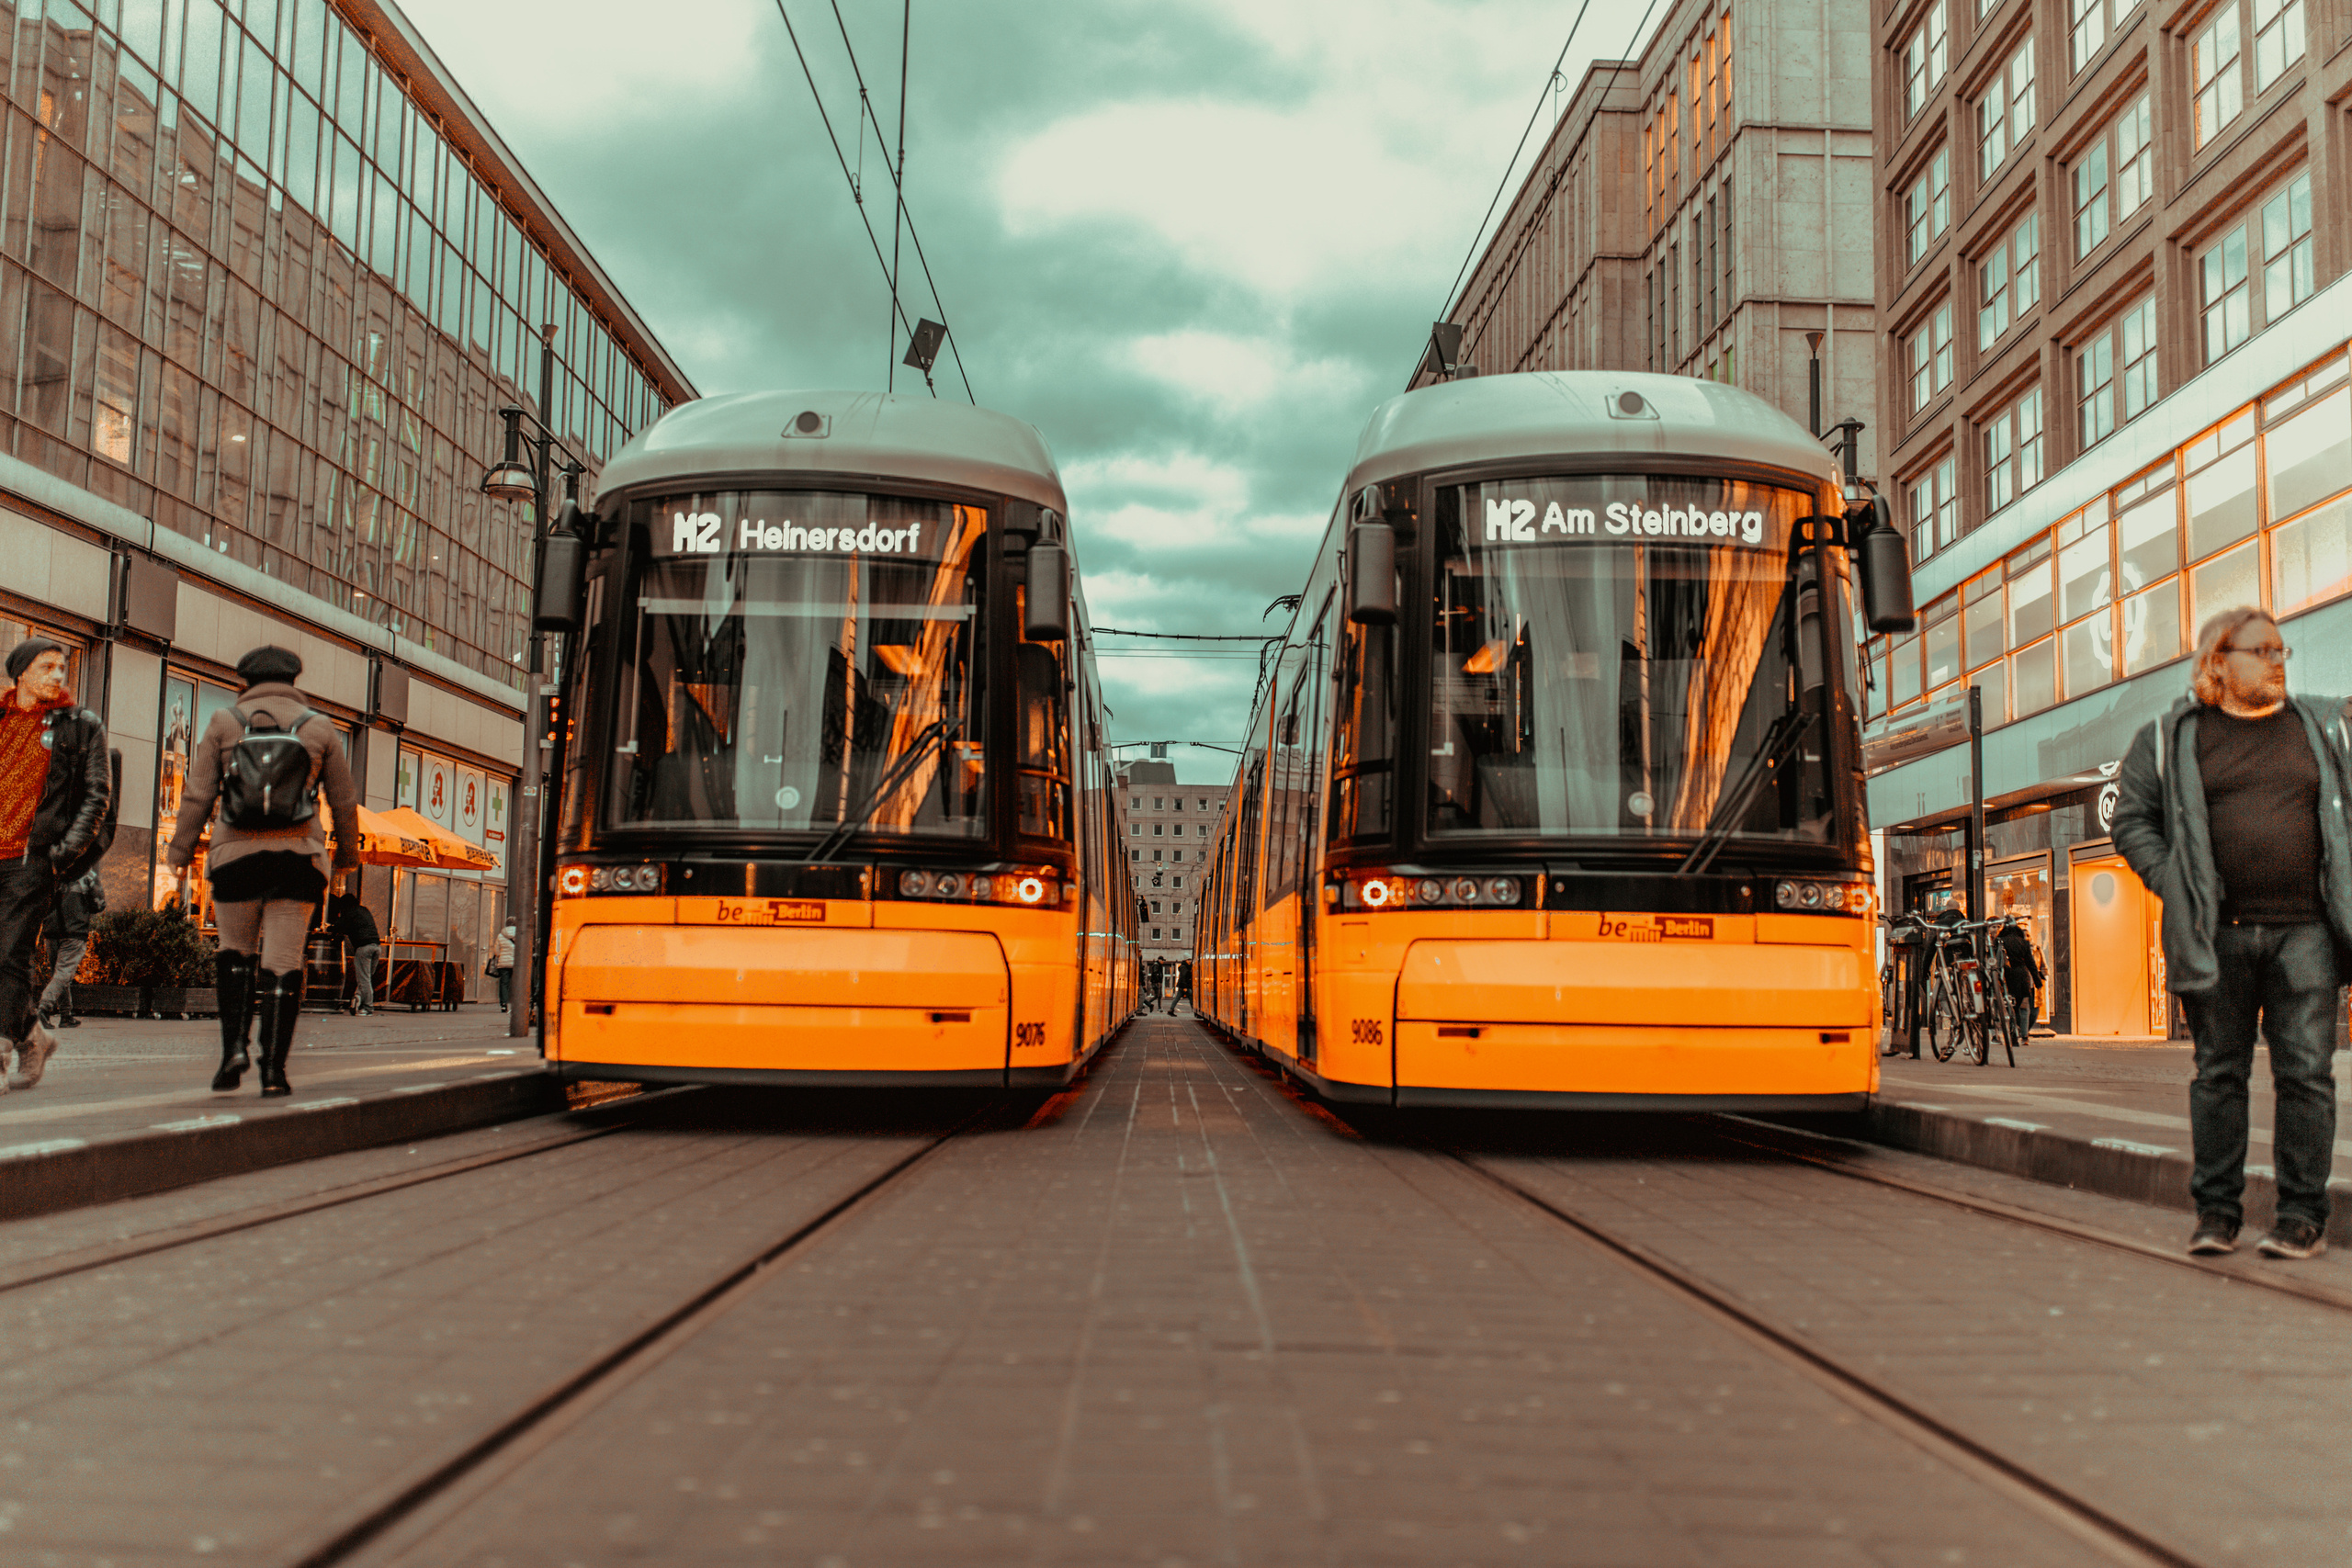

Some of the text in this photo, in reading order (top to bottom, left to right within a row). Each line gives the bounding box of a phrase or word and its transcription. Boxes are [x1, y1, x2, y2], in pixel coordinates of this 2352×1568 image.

[673, 512, 921, 553] M2 Heinersdorf
[1486, 499, 1762, 544] M2 Am Steinberg
[718, 900, 822, 920] be Berlin
[1599, 911, 1710, 937] be Berlin
[1016, 1021, 1046, 1047] 9076
[1351, 1019, 1383, 1045] 9086
